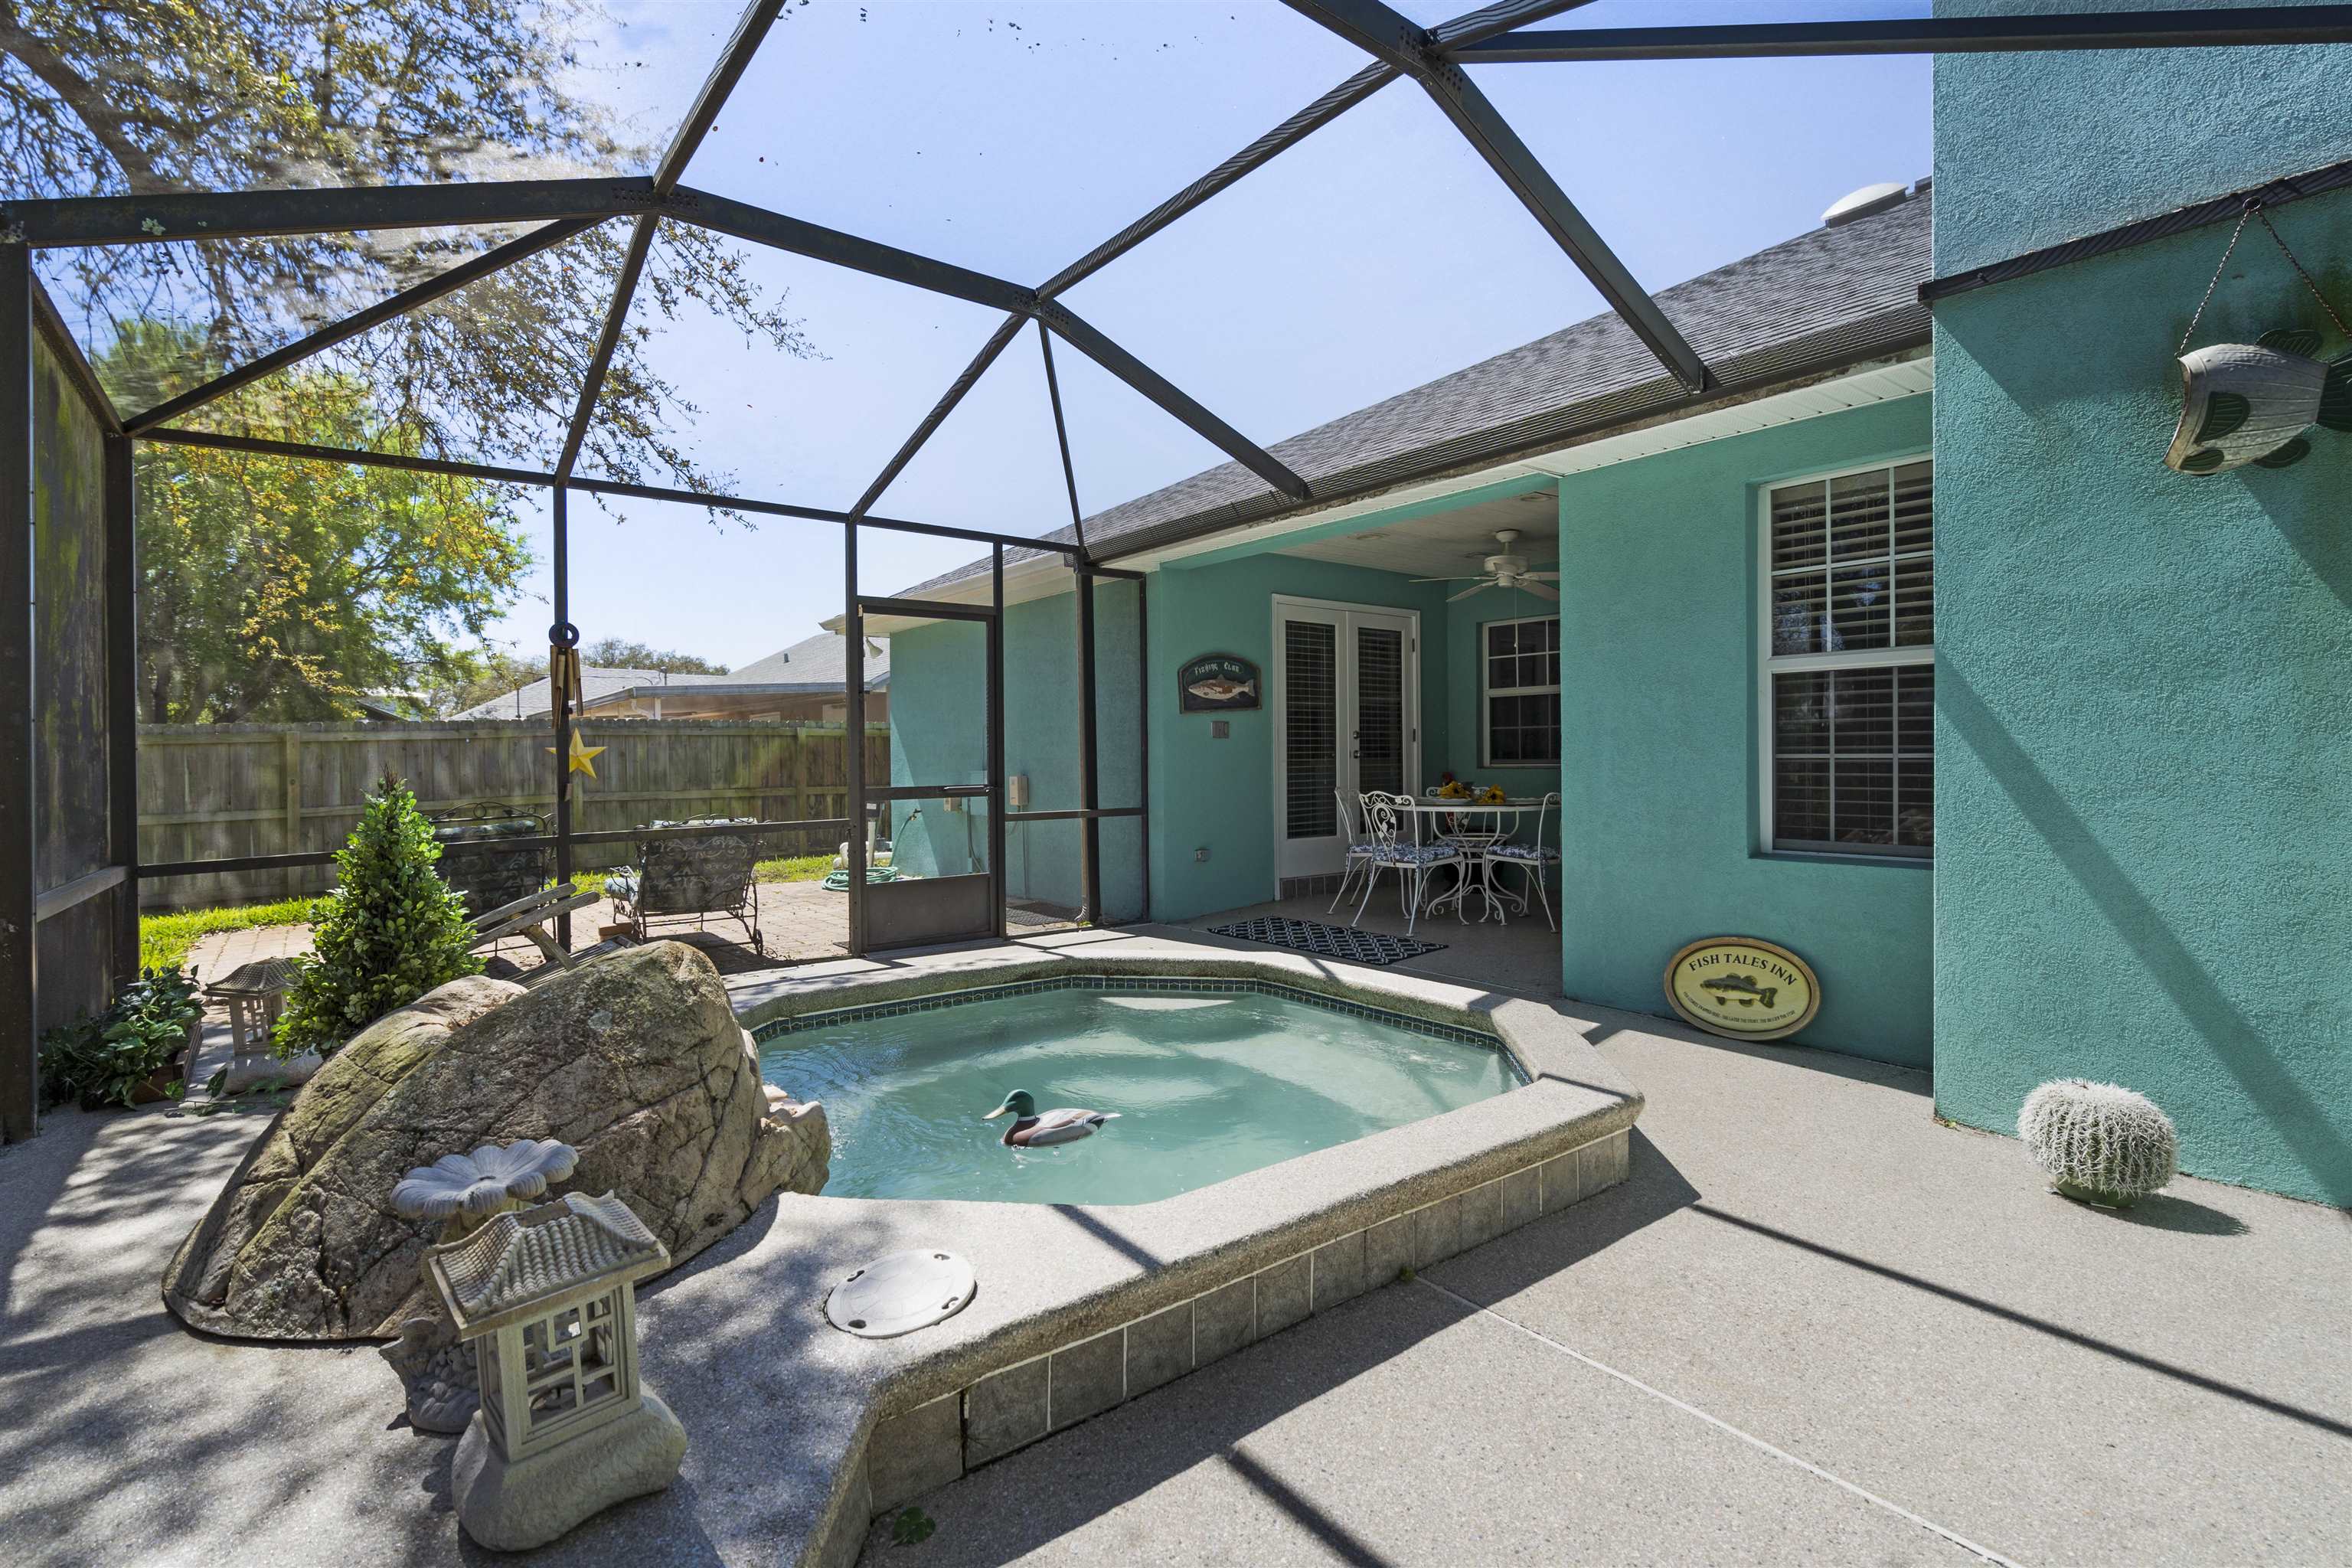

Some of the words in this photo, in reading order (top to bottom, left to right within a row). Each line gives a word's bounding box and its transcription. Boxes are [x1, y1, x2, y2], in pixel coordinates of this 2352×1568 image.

[1689, 954, 1720, 971] FISH
[1723, 953, 1769, 969] TALES
[1770, 964, 1797, 985] INN
